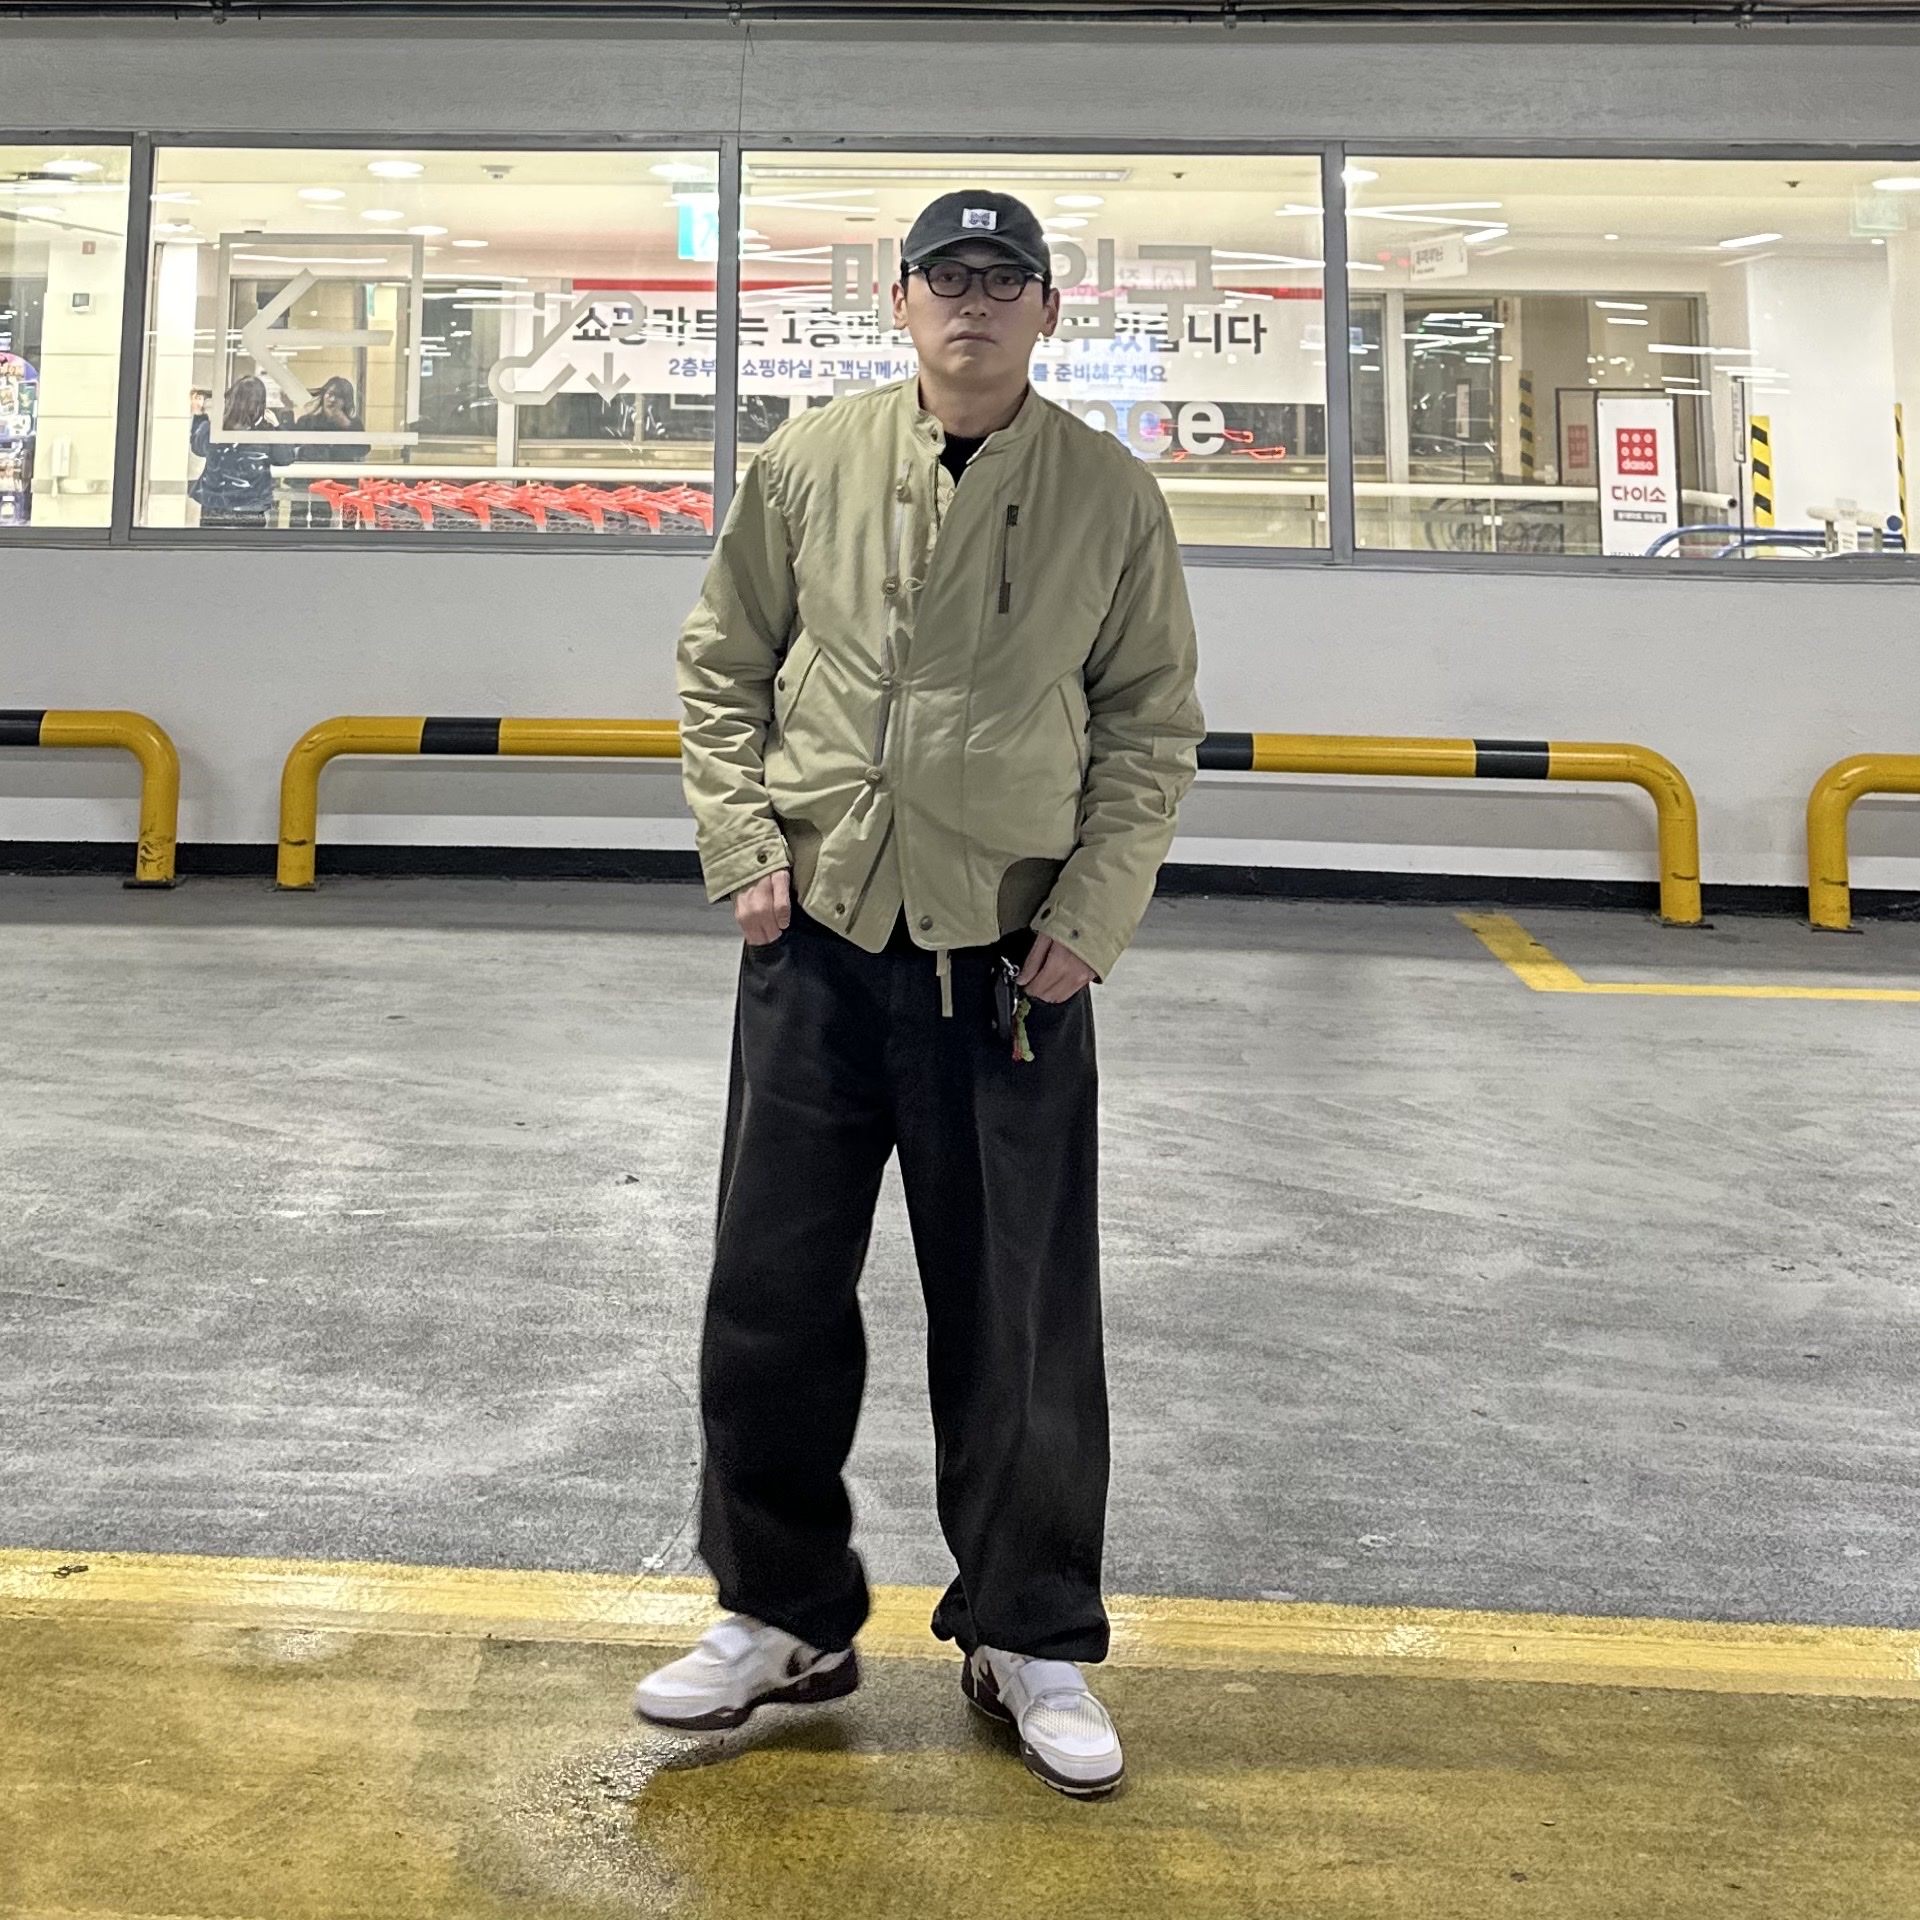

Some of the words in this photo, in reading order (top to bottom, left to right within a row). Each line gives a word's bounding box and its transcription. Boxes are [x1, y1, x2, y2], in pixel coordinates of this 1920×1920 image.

[781, 307, 916, 348] 1층에
[668, 357, 717, 378] 2층부
[741, 358, 812, 379] 쇼핑하실
[818, 359, 919, 379] 고객님께서
[1054, 362, 1168, 383] 준비해주세요
[1611, 485, 1667, 503] 다이소
